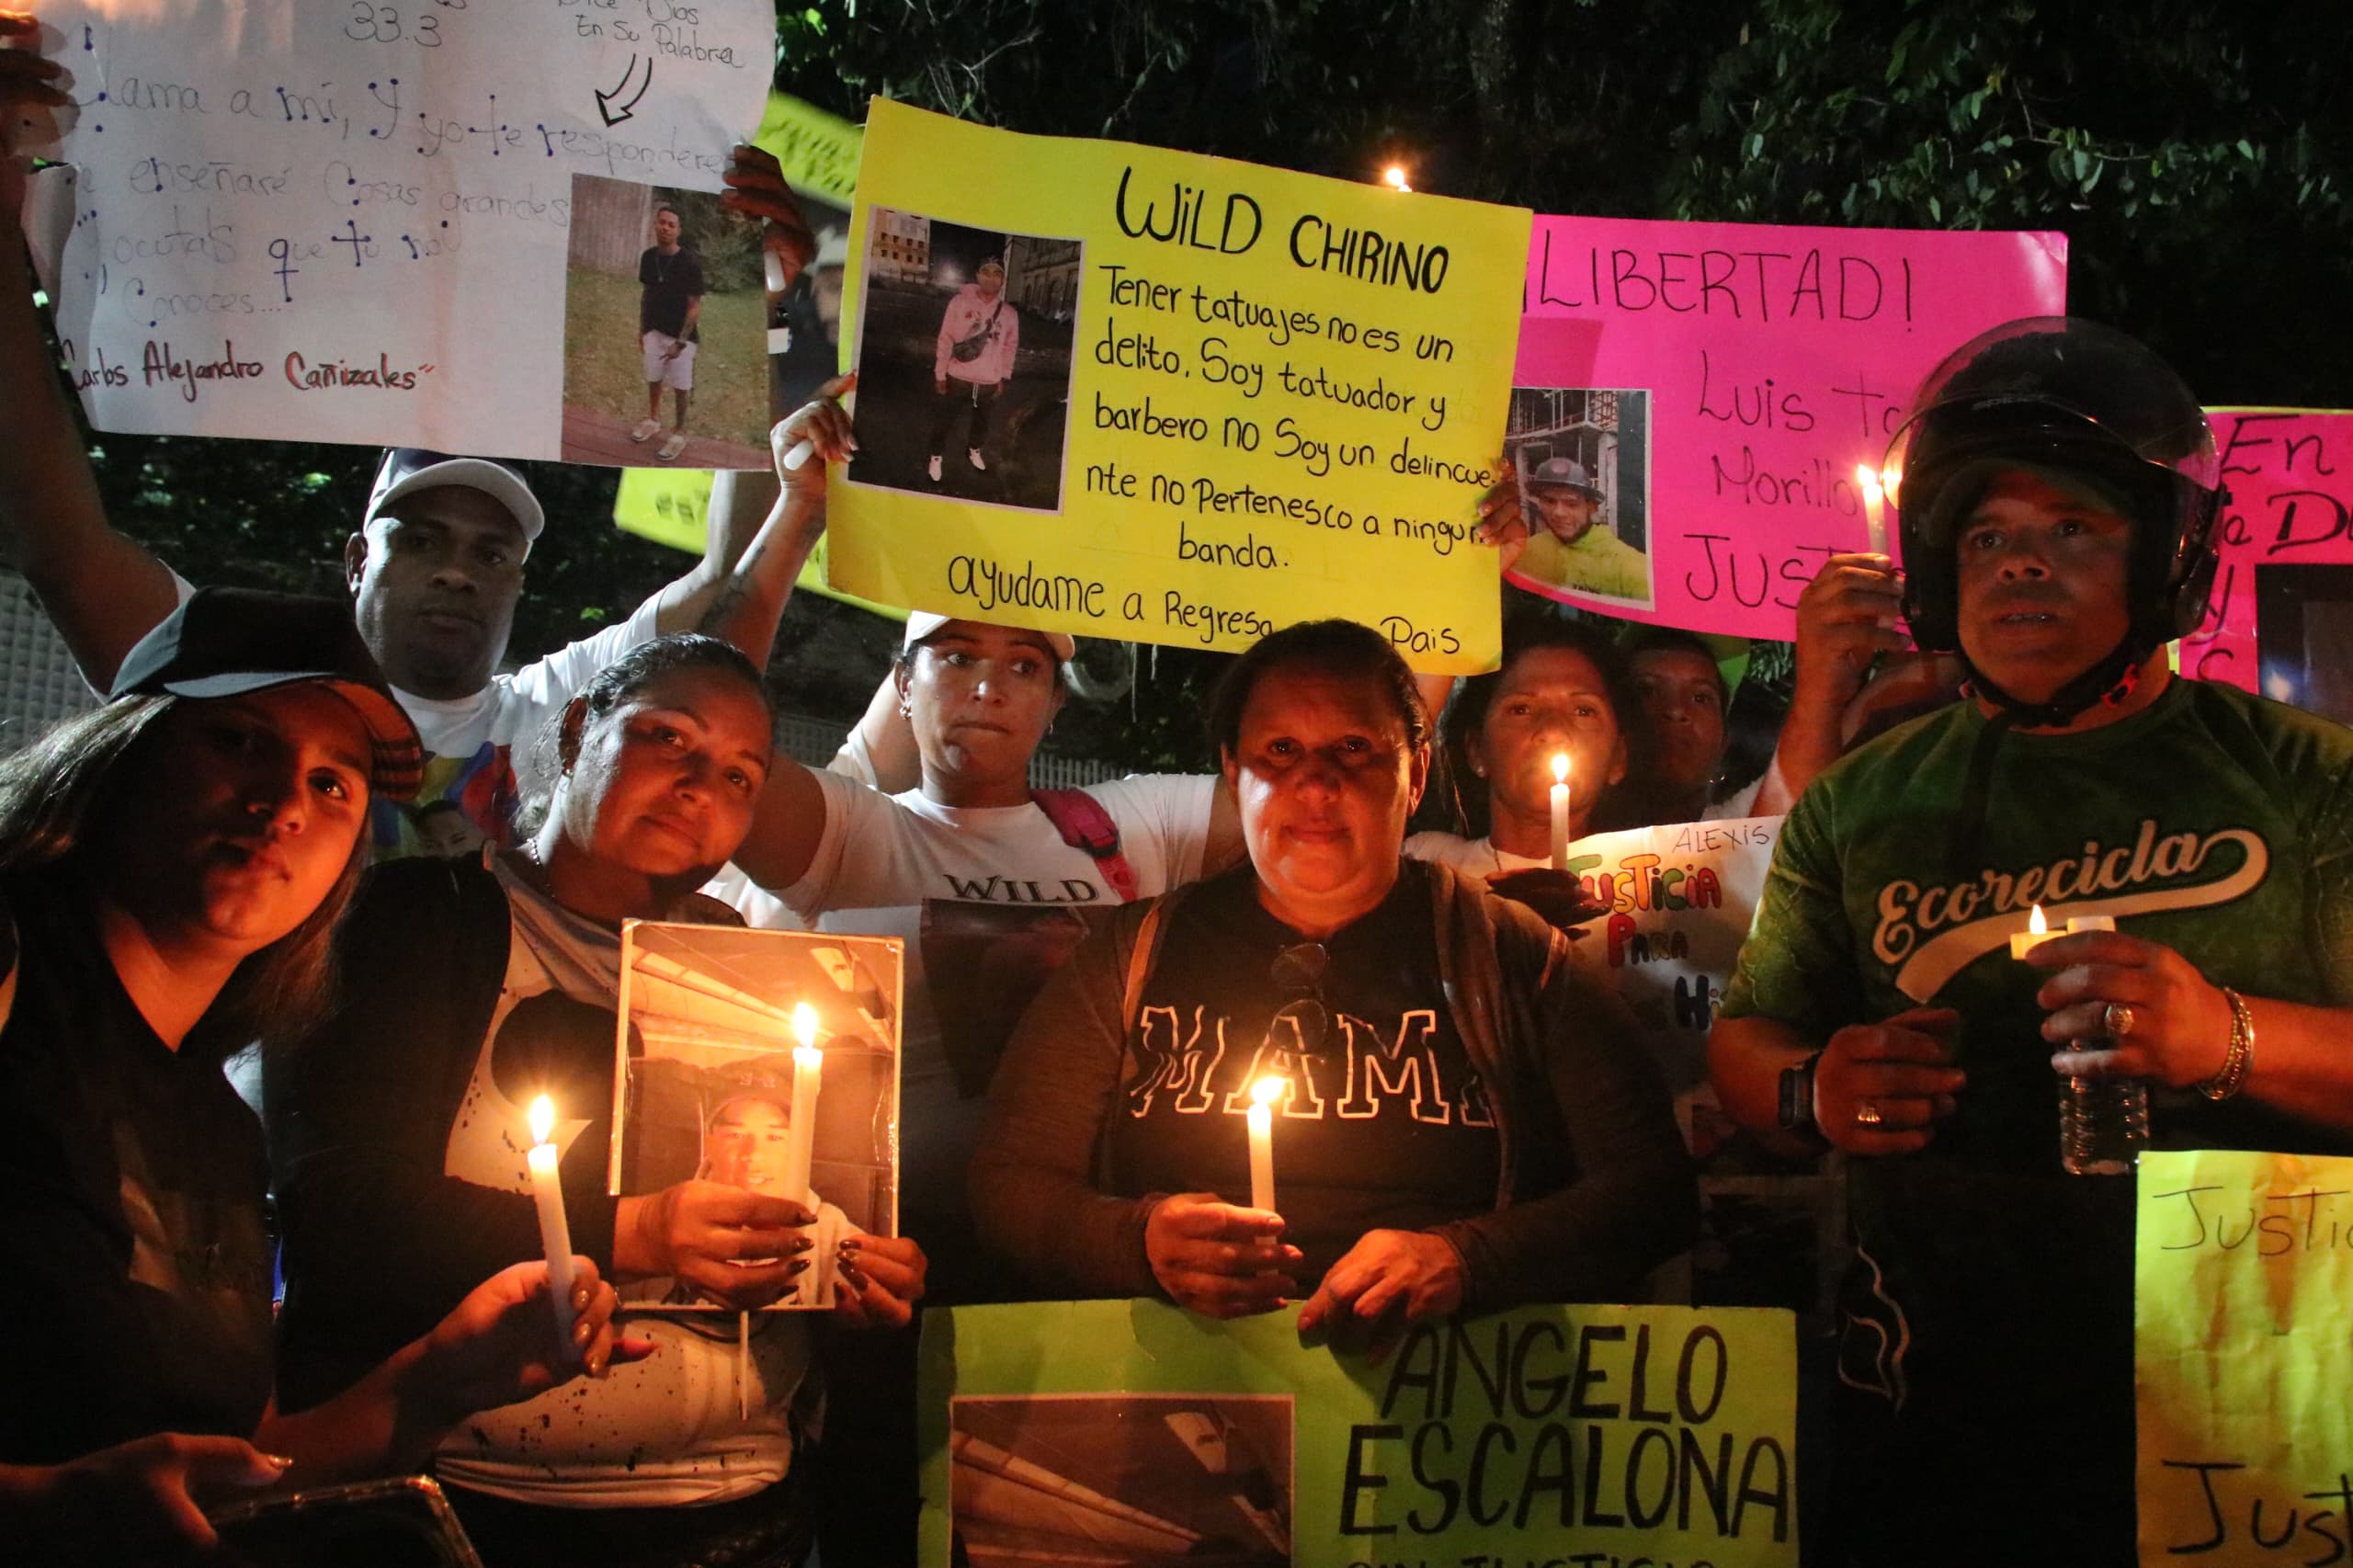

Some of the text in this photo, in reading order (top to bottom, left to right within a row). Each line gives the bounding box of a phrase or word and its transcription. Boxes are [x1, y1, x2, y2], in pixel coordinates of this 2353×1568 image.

[575, 15, 745, 68] En Su Palabra
[230, 90, 260, 119] a
[418, 111, 463, 159] yo
[469, 95, 524, 156] te
[129, 158, 296, 197] enseñaré
[1289, 213, 1449, 294] CHIRINO
[1098, 264, 1454, 363] Tener tatuajes no es un
[142, 338, 264, 403] Alejandro
[1200, 336, 1264, 399] Soy
[1278, 362, 1416, 414] tatuador
[1421, 397, 1446, 431] y
[1095, 391, 1208, 441] barbero
[1223, 416, 1260, 452] no
[1274, 417, 1331, 477] Soy
[1339, 443, 1375, 466] un
[1086, 463, 1137, 499] nte
[1151, 472, 1186, 506] no
[1191, 477, 1354, 530] Pertenesco
[1362, 516, 1381, 536] a
[1178, 522, 1290, 569] banda.
[1122, 593, 1145, 621] a
[943, 873, 1101, 903] WILD
[1872, 820, 2208, 965] Ecorecicla
[1381, 1321, 1728, 1425] ANGELO
[1339, 1421, 1788, 1543] ESCALONA
